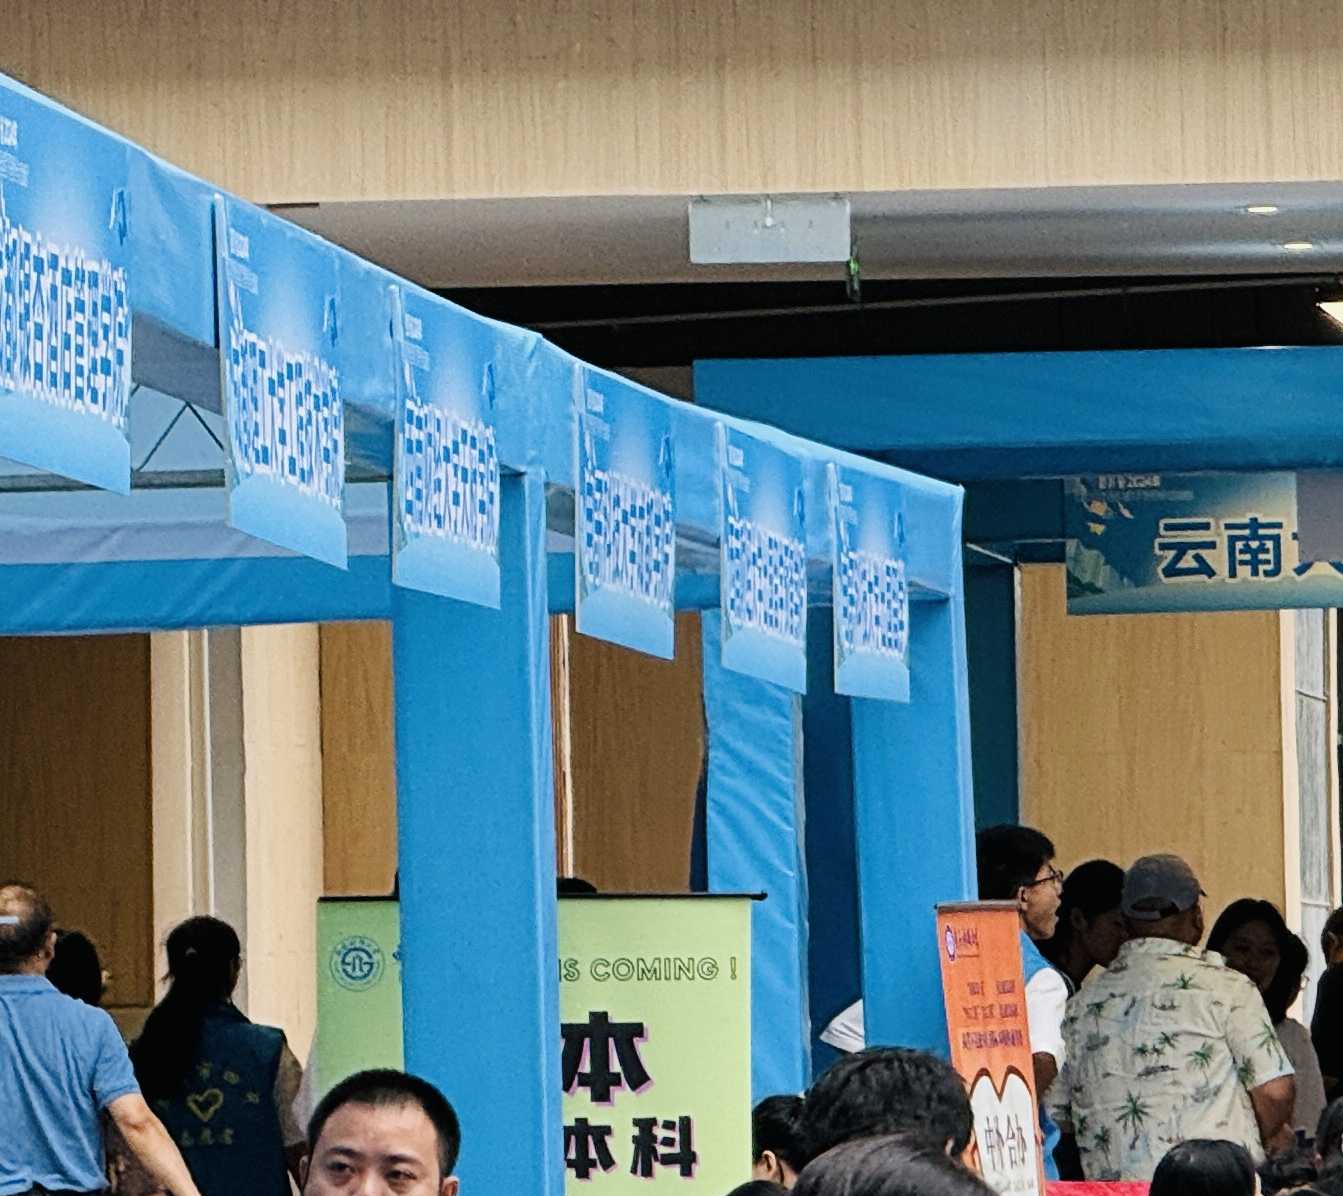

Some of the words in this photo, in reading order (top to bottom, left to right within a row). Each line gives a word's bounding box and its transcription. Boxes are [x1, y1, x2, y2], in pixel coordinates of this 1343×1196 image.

[590, 956, 719, 982] COMING
[729, 956, 738, 980] !
[561, 1011, 653, 1104] 本
[564, 1115, 698, 1180] 本科
